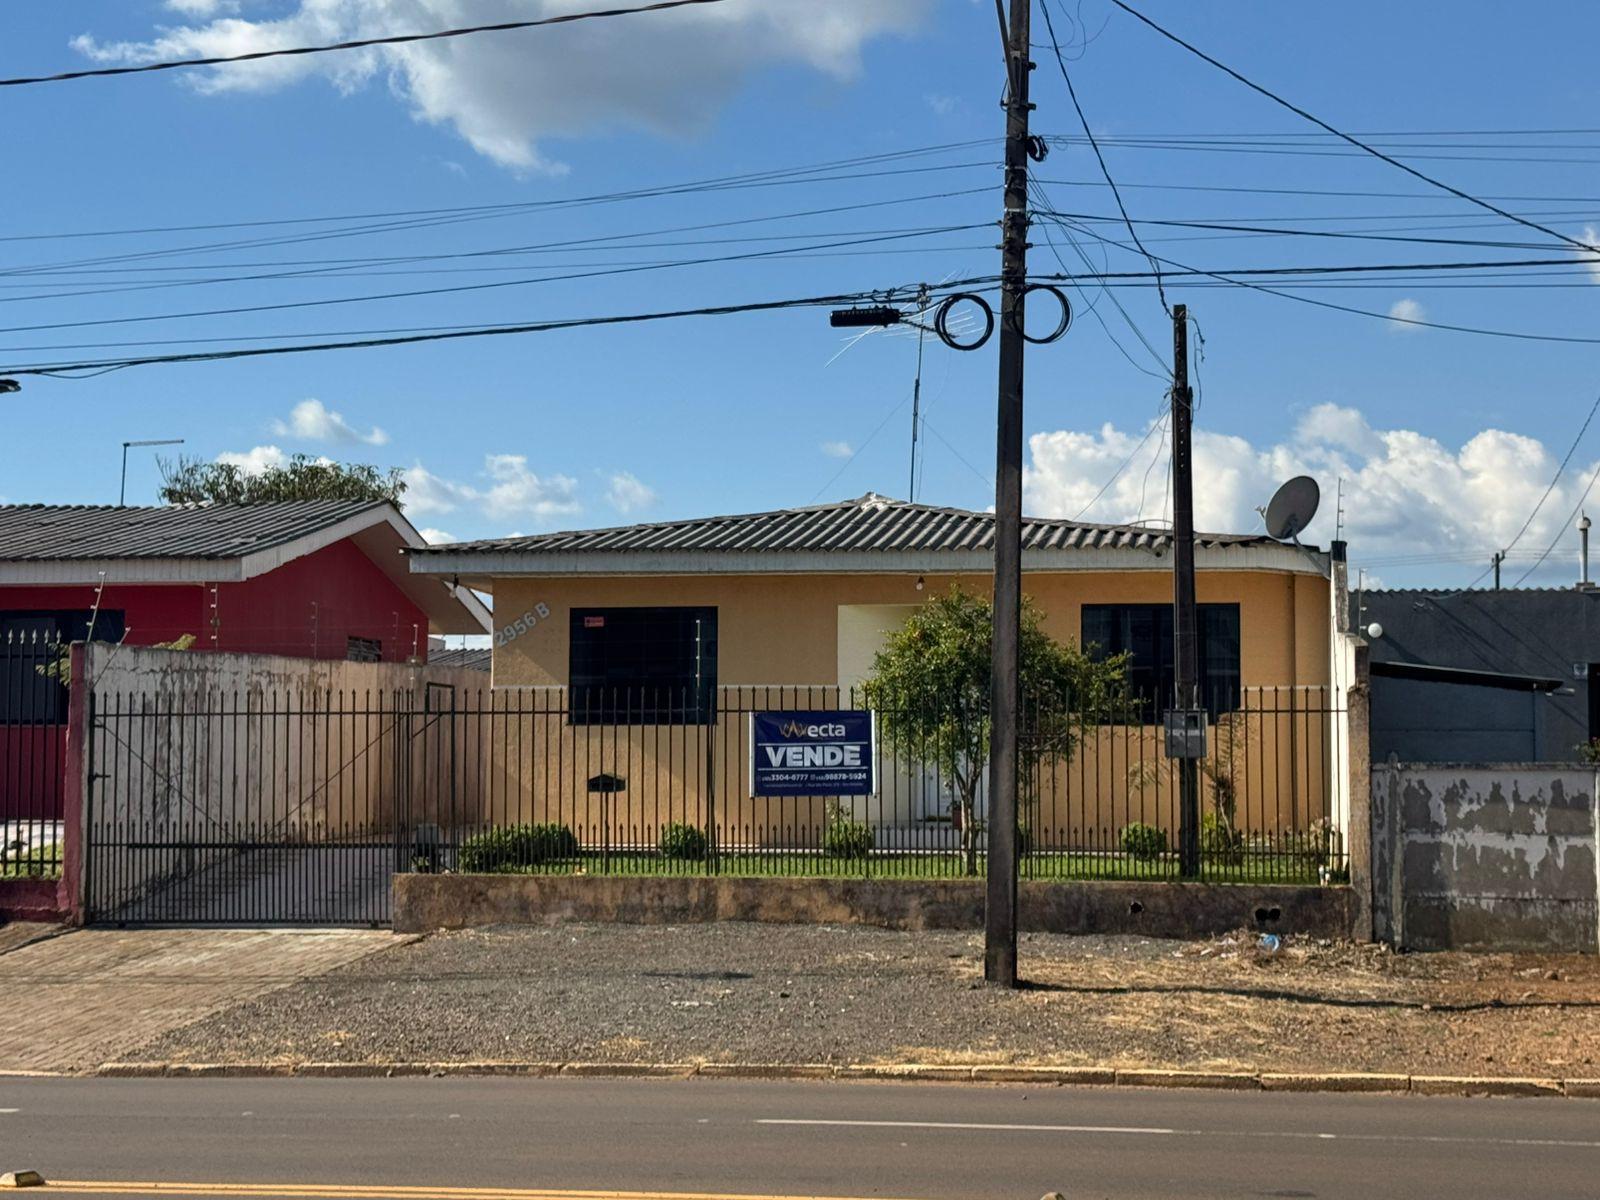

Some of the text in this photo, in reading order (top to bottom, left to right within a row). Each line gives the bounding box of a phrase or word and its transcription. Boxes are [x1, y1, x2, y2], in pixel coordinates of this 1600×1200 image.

[494, 601, 550, 647] 2956 B
[765, 745, 861, 767] VENDE
